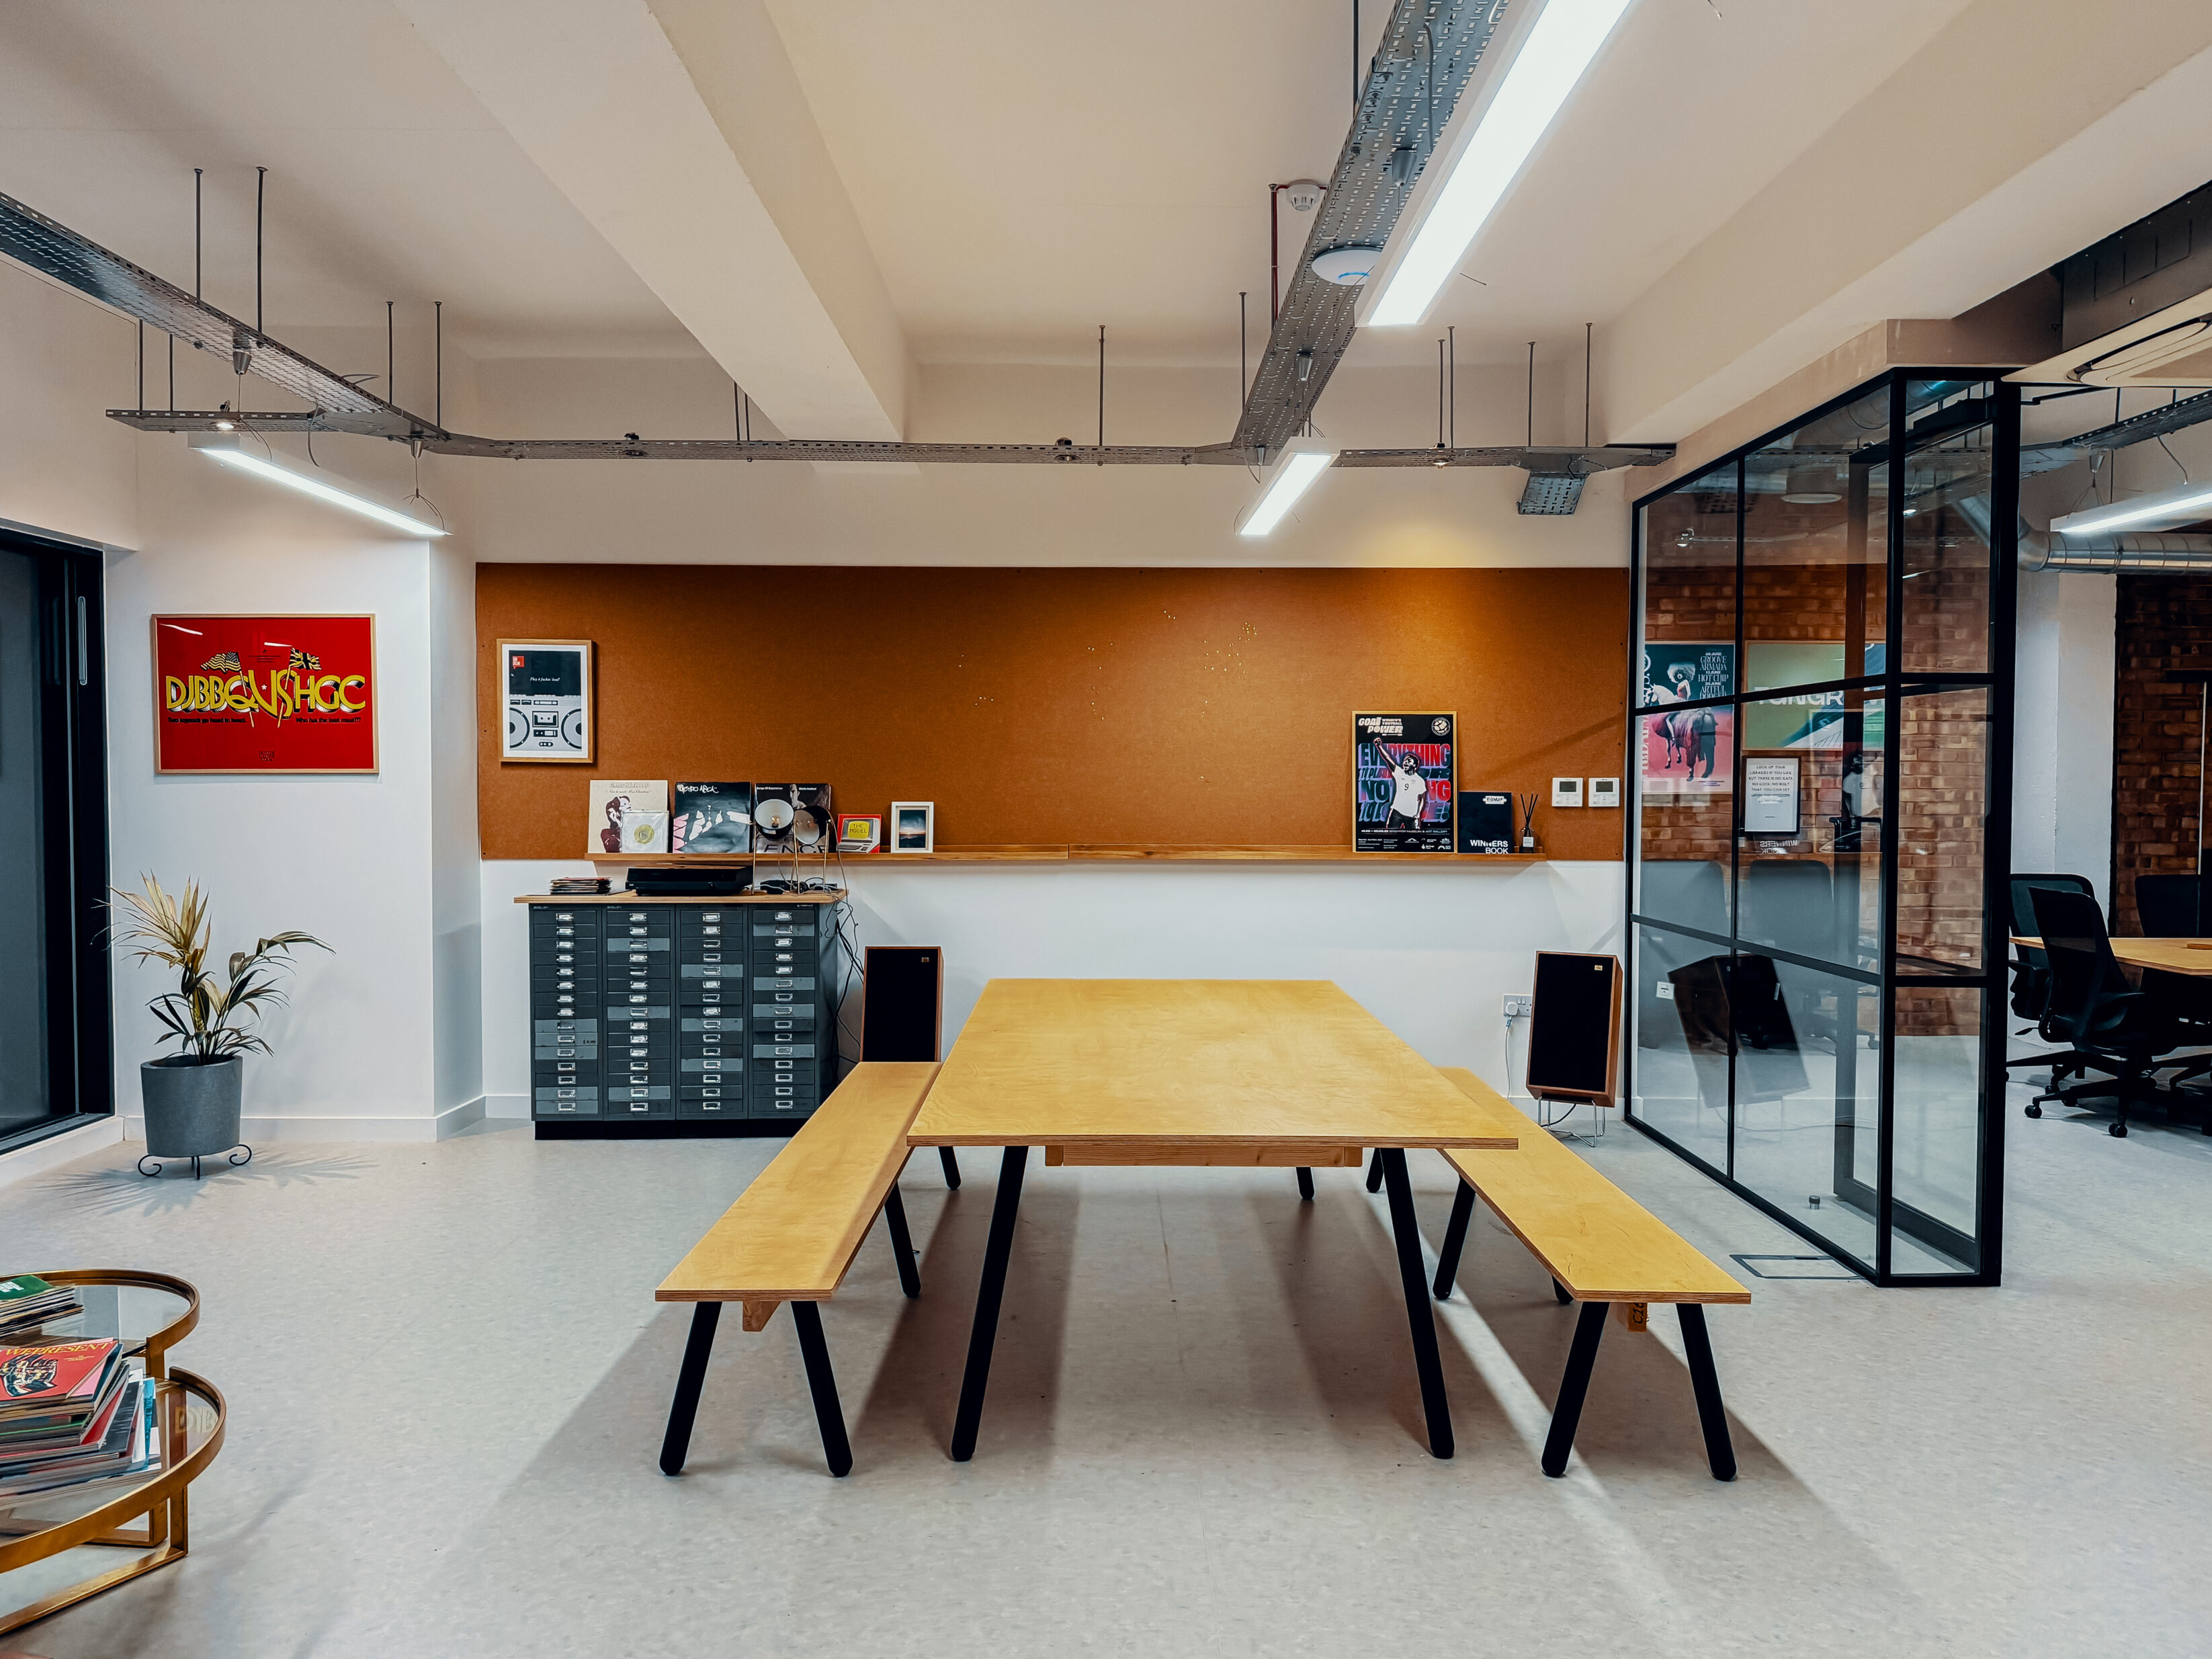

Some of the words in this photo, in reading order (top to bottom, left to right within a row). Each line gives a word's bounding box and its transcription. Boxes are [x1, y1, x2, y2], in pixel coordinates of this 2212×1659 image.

[1698, 674, 1713, 682] HOT
[1713, 674, 1729, 682] CHIP
[166, 675, 259, 713] DJBBQ
[294, 675, 366, 713] HGC
[1470, 839, 1508, 847] WINNERS
[6, 1342, 112, 1355] WEPRESENT
